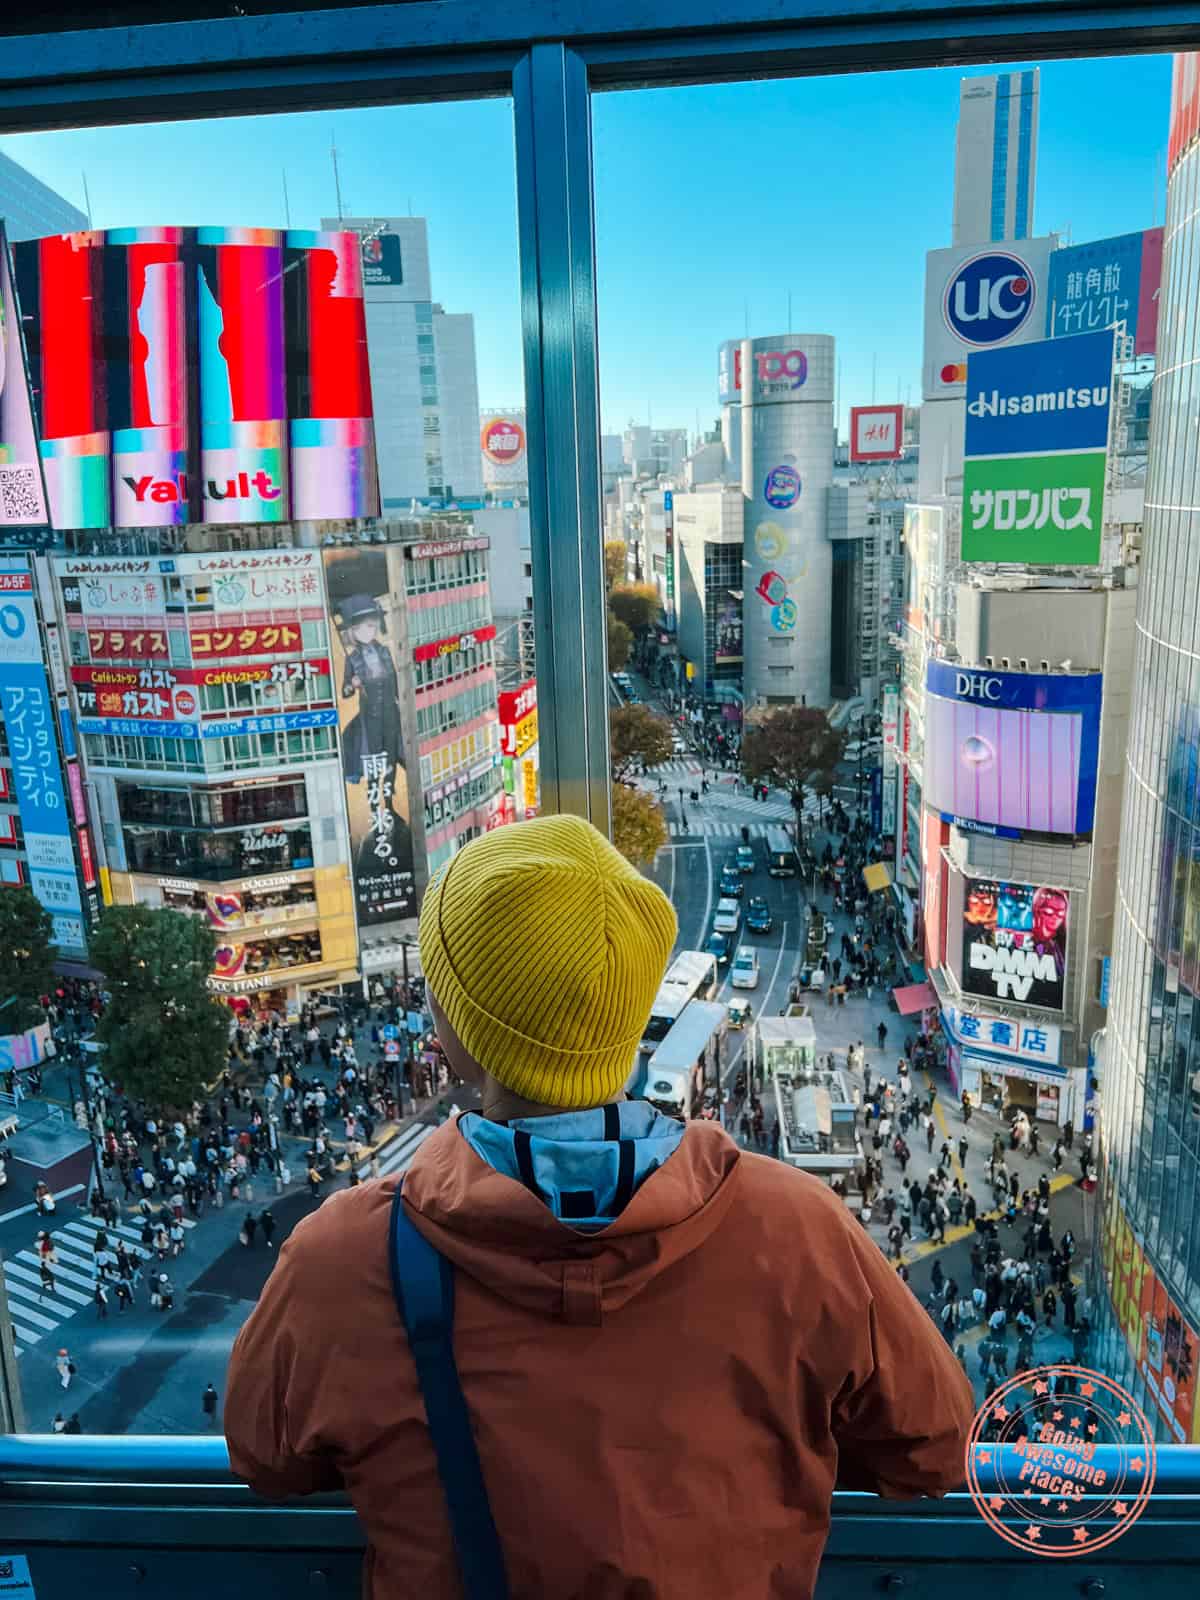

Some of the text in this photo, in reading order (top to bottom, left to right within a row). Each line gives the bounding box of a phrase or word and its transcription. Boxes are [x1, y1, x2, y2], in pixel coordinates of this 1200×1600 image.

[1066, 262, 1121, 300] 龍角散
[1058, 296, 1129, 332] ダイレクト
[755, 349, 808, 390] 109
[967, 386, 1108, 418] Hisamitsu
[970, 487, 1093, 530] サロンパス
[65, 587, 80, 602] 9F
[251, 572, 318, 598] しゃぶ葉
[90, 632, 167, 653] プライス
[191, 626, 298, 653] コンタクト
[139, 667, 177, 689] ガスト
[271, 661, 319, 683] ガスト
[955, 672, 1003, 701] DHC
[79, 692, 96, 708] 7F
[122, 690, 170, 716] ガスト
[5, 686, 38, 808] アイシティ
[29, 687, 59, 808] コンタクトの
[360, 751, 398, 866] 雨が来る。
[970, 942, 1058, 982] DMM
[992, 971, 1034, 1001] TV
[949, 1008, 1048, 1053] 堂書店
